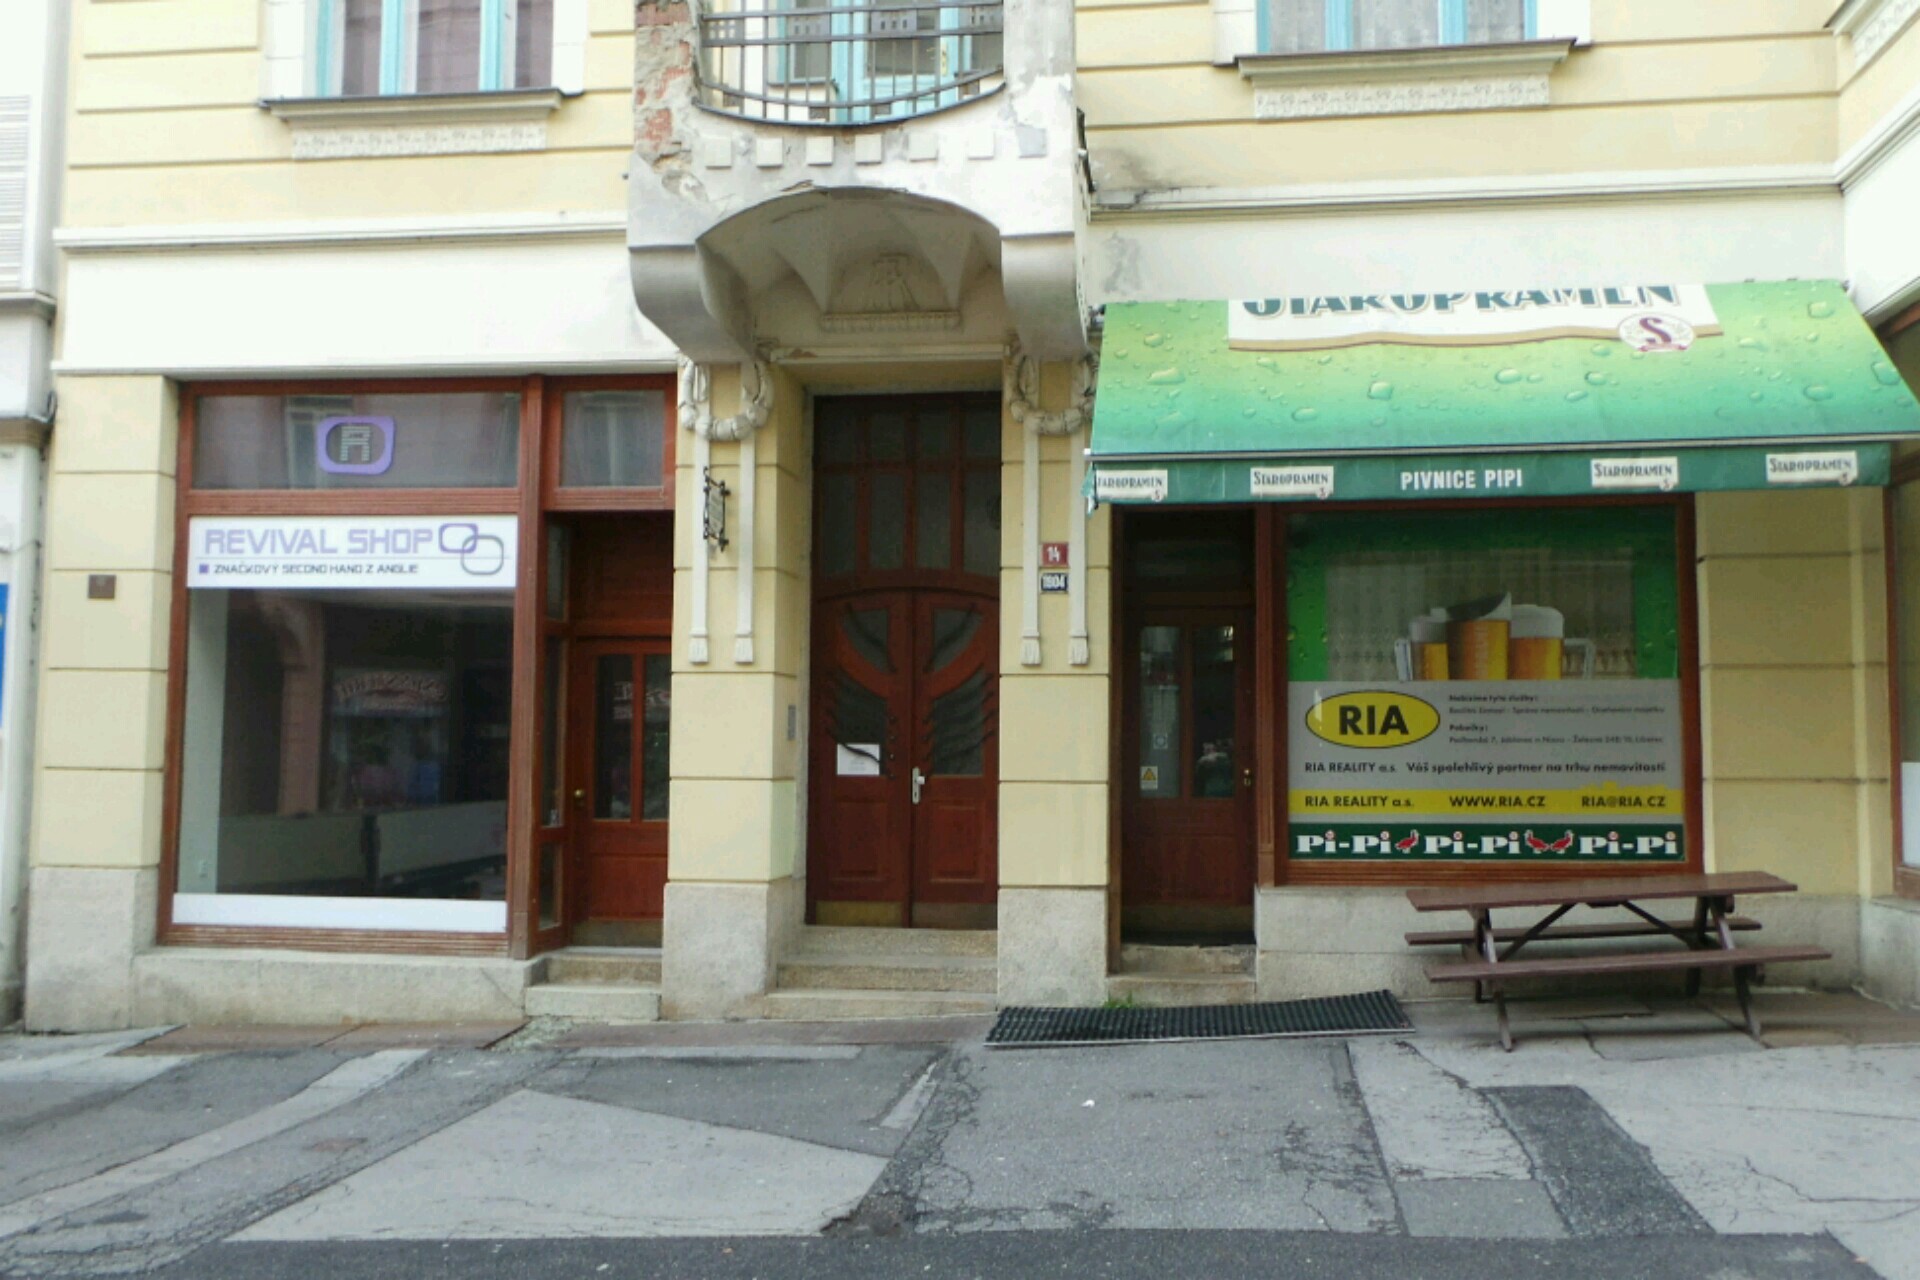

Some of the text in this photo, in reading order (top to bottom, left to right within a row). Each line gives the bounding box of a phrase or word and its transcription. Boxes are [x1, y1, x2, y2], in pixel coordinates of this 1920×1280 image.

[1097, 476, 1163, 489] TAROPRAMEN
[1401, 469, 1523, 490] PIVNICE PIPI
[205, 528, 433, 554] REVIVAL SHOP
[1047, 546, 1060, 562] 14
[282, 563, 327, 574] SECOND
[330, 563, 362, 574] HAND
[365, 563, 373, 574] Z
[377, 563, 419, 574] ANGLIE
[1339, 704, 1409, 736] RIA
[1304, 762, 1325, 773] RIA
[1329, 762, 1376, 773] REALITY
[1406, 760, 1429, 773] Váš
[1432, 761, 1494, 775] spolehlivý
[1497, 763, 1543, 775] partner
[1546, 763, 1562, 773] na
[1565, 761, 1590, 773] trhu
[1593, 761, 1666, 773] nemovitostí
[1304, 796, 1329, 807] RIA
[1333, 796, 1388, 807] REALITY
[1449, 796, 1546, 807] WWW.RIA.CZ
[1581, 796, 1666, 807] RIA@RIA.CZ
[1297, 829, 1678, 854] Pi-Pi Pi-Pi Pi-Pi
